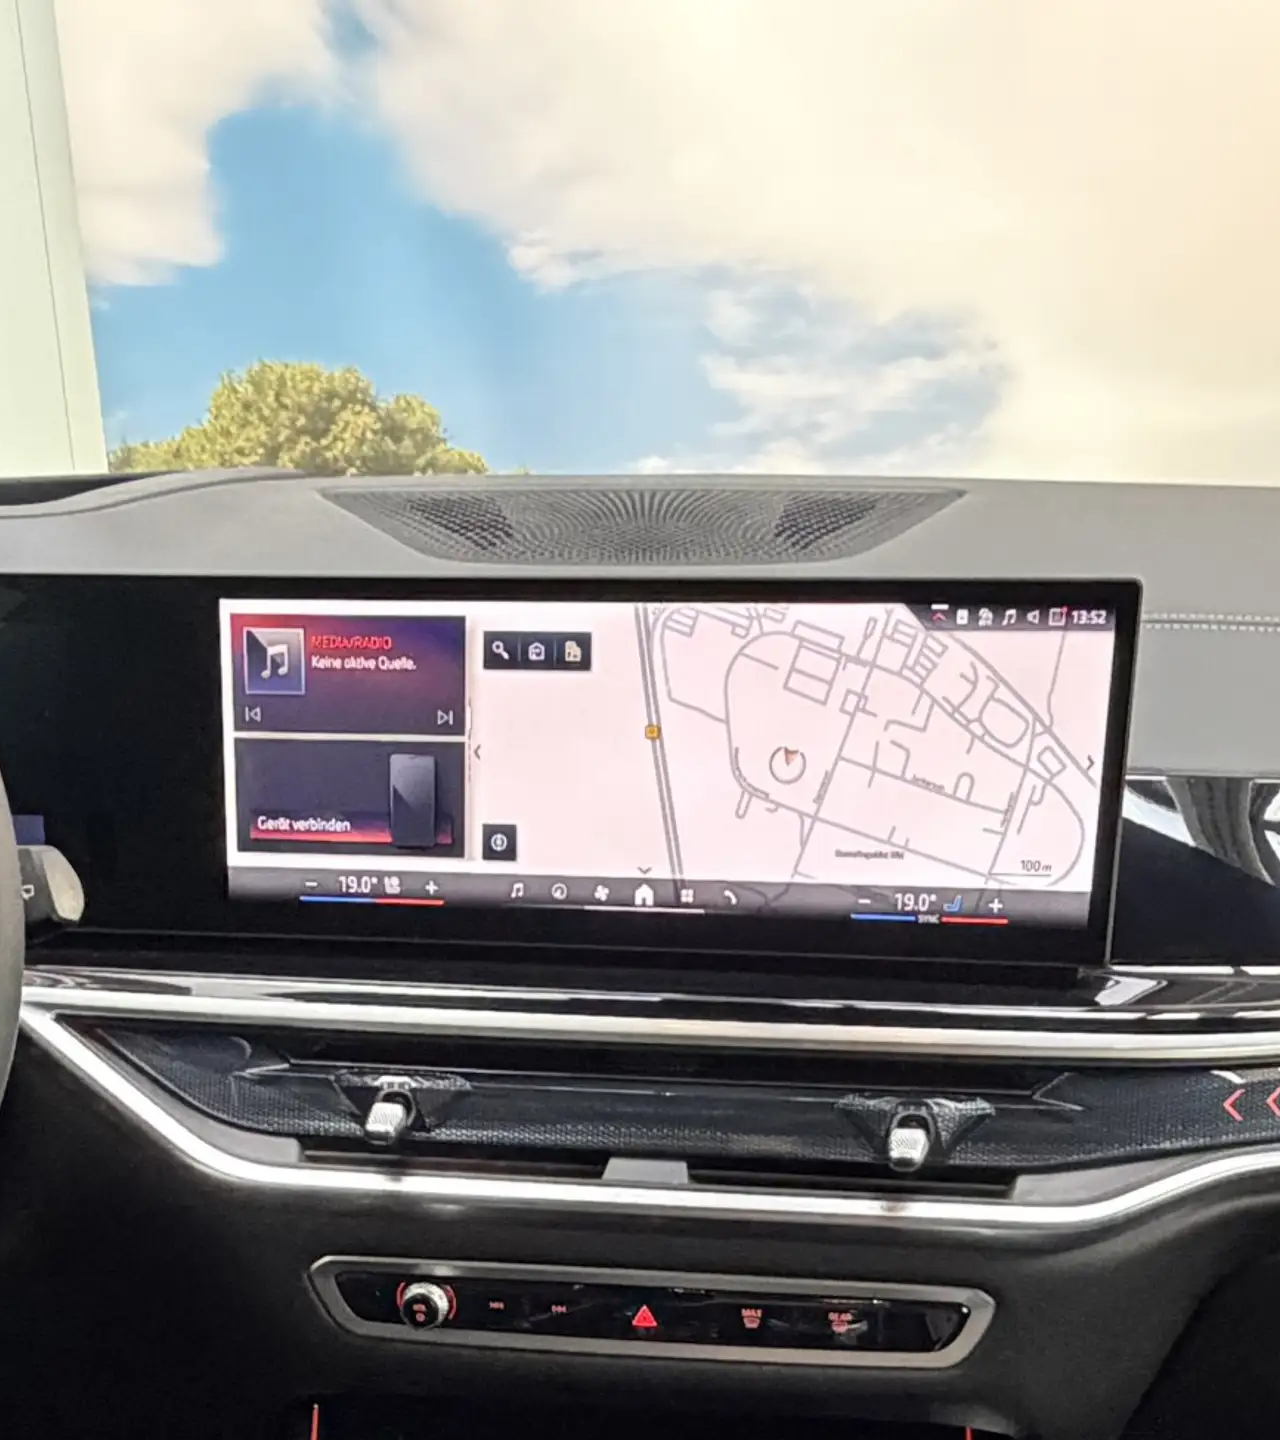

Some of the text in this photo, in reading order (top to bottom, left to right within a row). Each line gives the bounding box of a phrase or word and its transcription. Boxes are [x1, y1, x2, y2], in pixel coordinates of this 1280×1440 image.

[1071, 610, 1107, 625] 13:52
[311, 656, 342, 669] Keine
[344, 656, 376, 670] aktive
[257, 815, 352, 833] Gerät verbinden
[1020, 860, 1041, 873] 100
